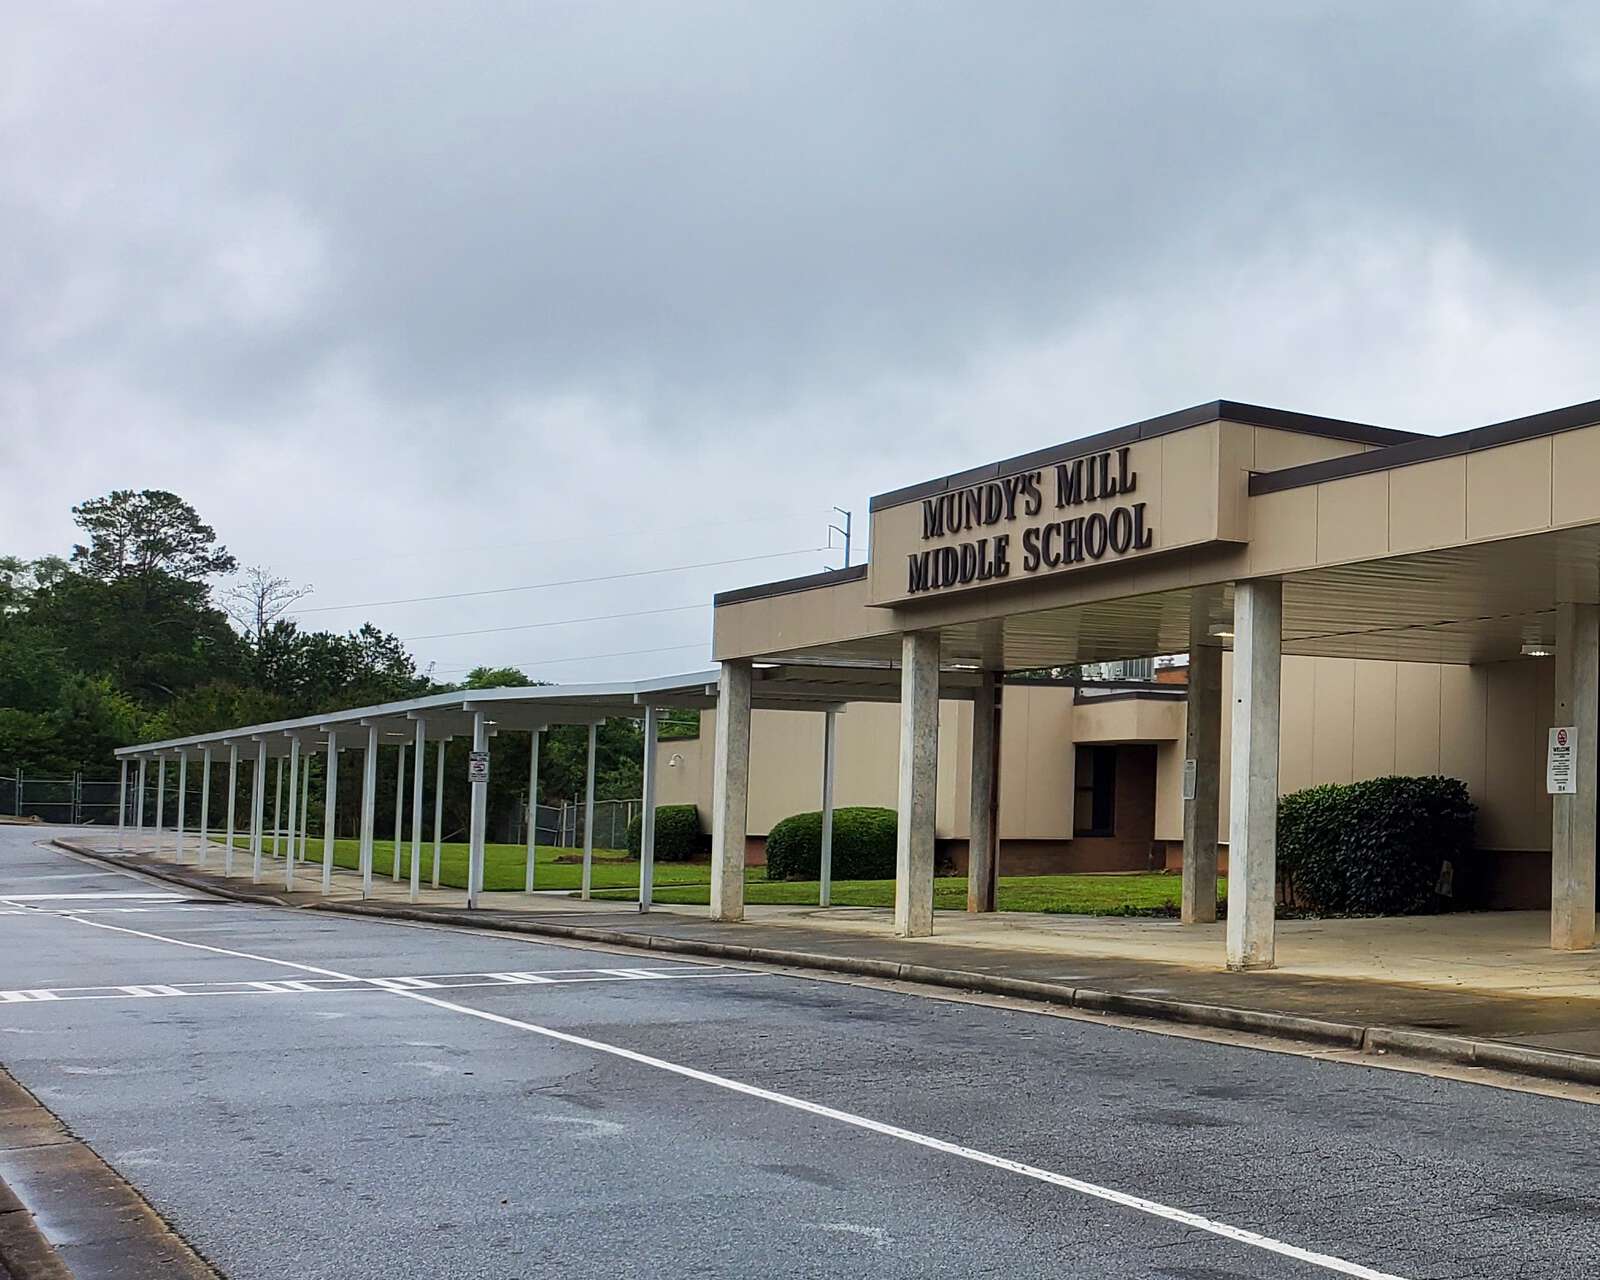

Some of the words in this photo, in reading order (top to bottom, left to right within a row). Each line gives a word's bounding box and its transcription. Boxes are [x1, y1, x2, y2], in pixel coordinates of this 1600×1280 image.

[922, 472, 1042, 540] MUNDY'S
[1055, 447, 1137, 508] MILL
[907, 534, 1010, 594] MIDDLE
[1023, 503, 1153, 572] SCHOOL
